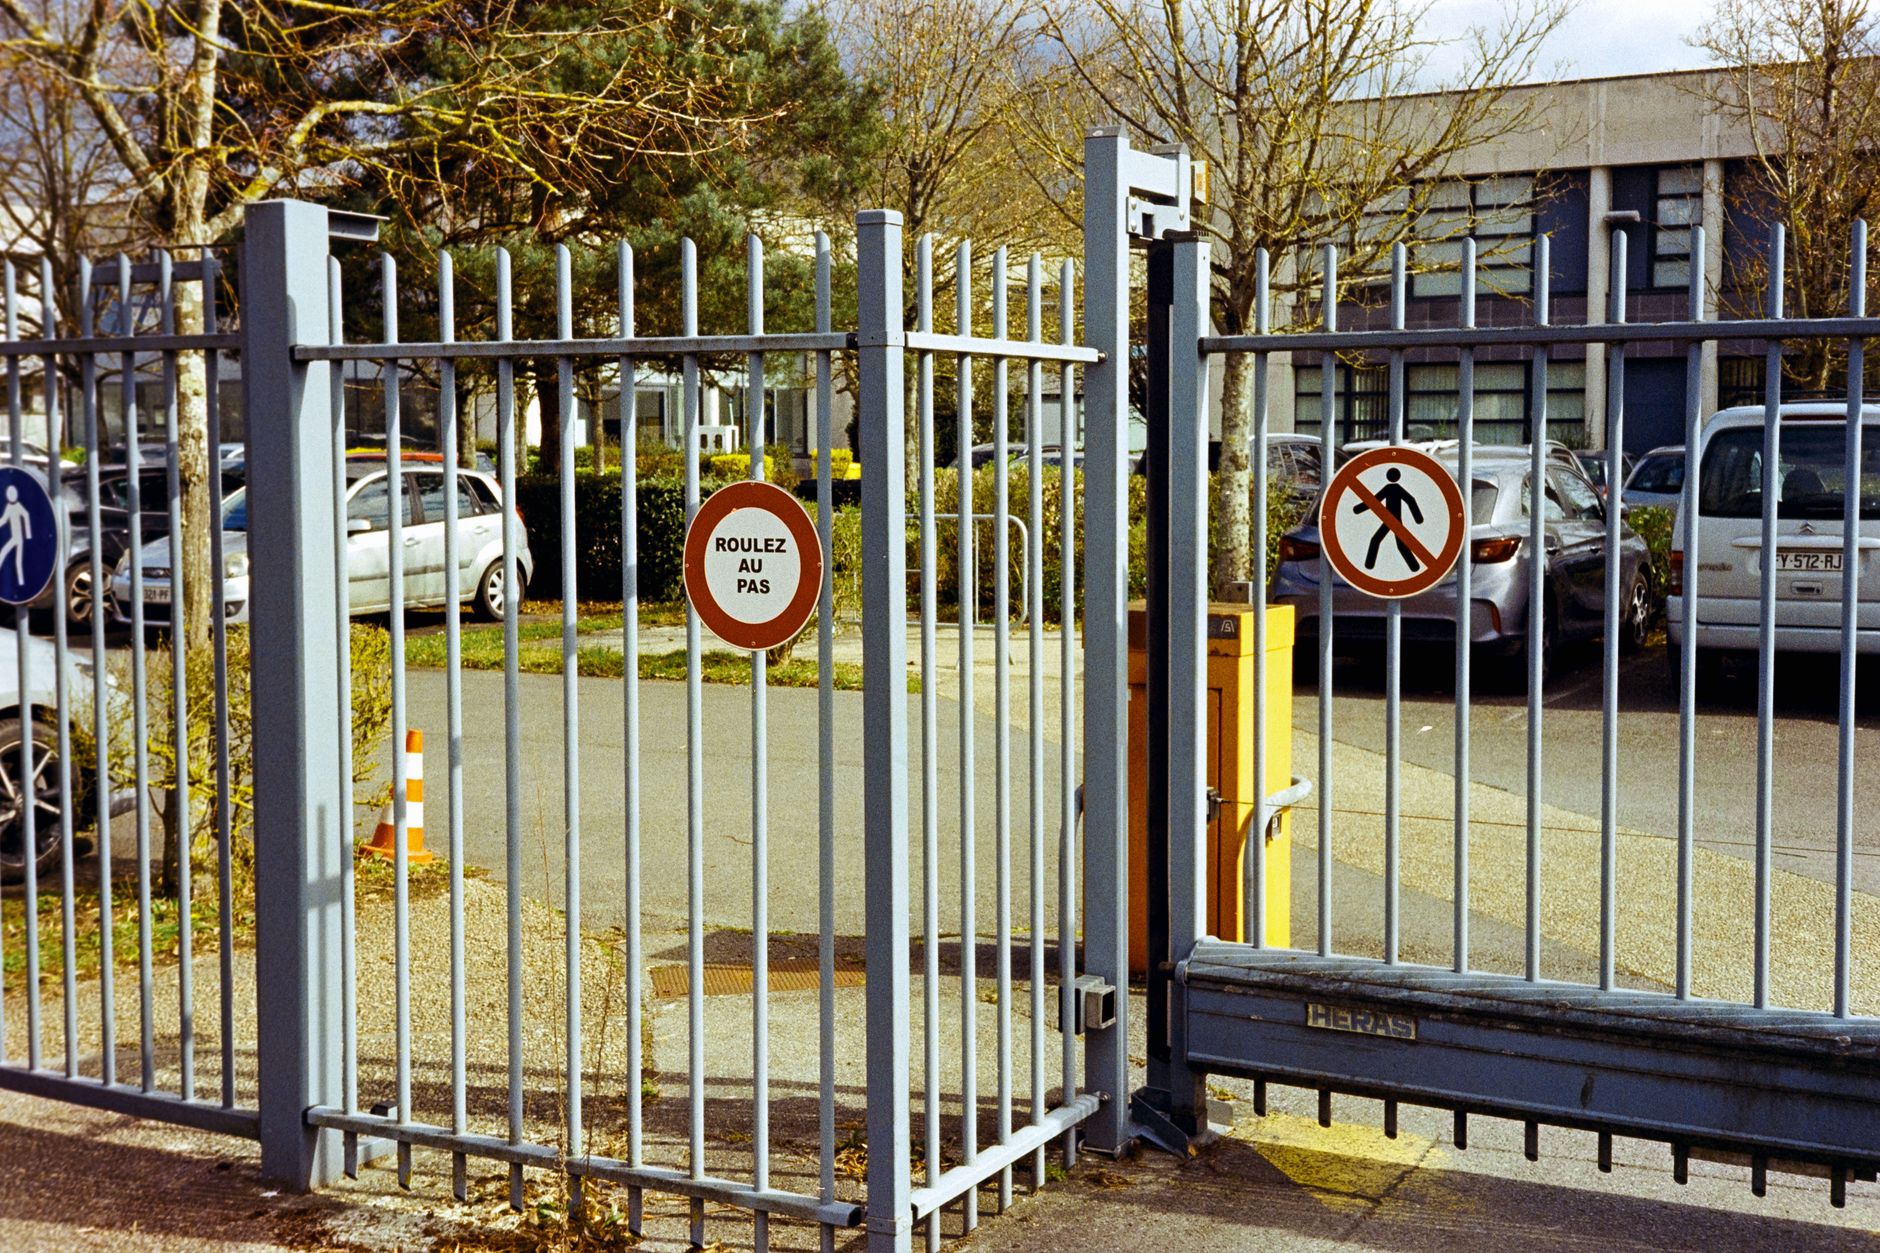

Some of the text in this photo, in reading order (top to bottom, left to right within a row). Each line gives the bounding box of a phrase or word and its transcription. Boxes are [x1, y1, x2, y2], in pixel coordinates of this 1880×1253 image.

[715, 537, 787, 553] ROULEZ
[738, 558, 763, 574] AU
[737, 578, 771, 594] PAS
[1311, 1003, 1412, 1038] HERAS
